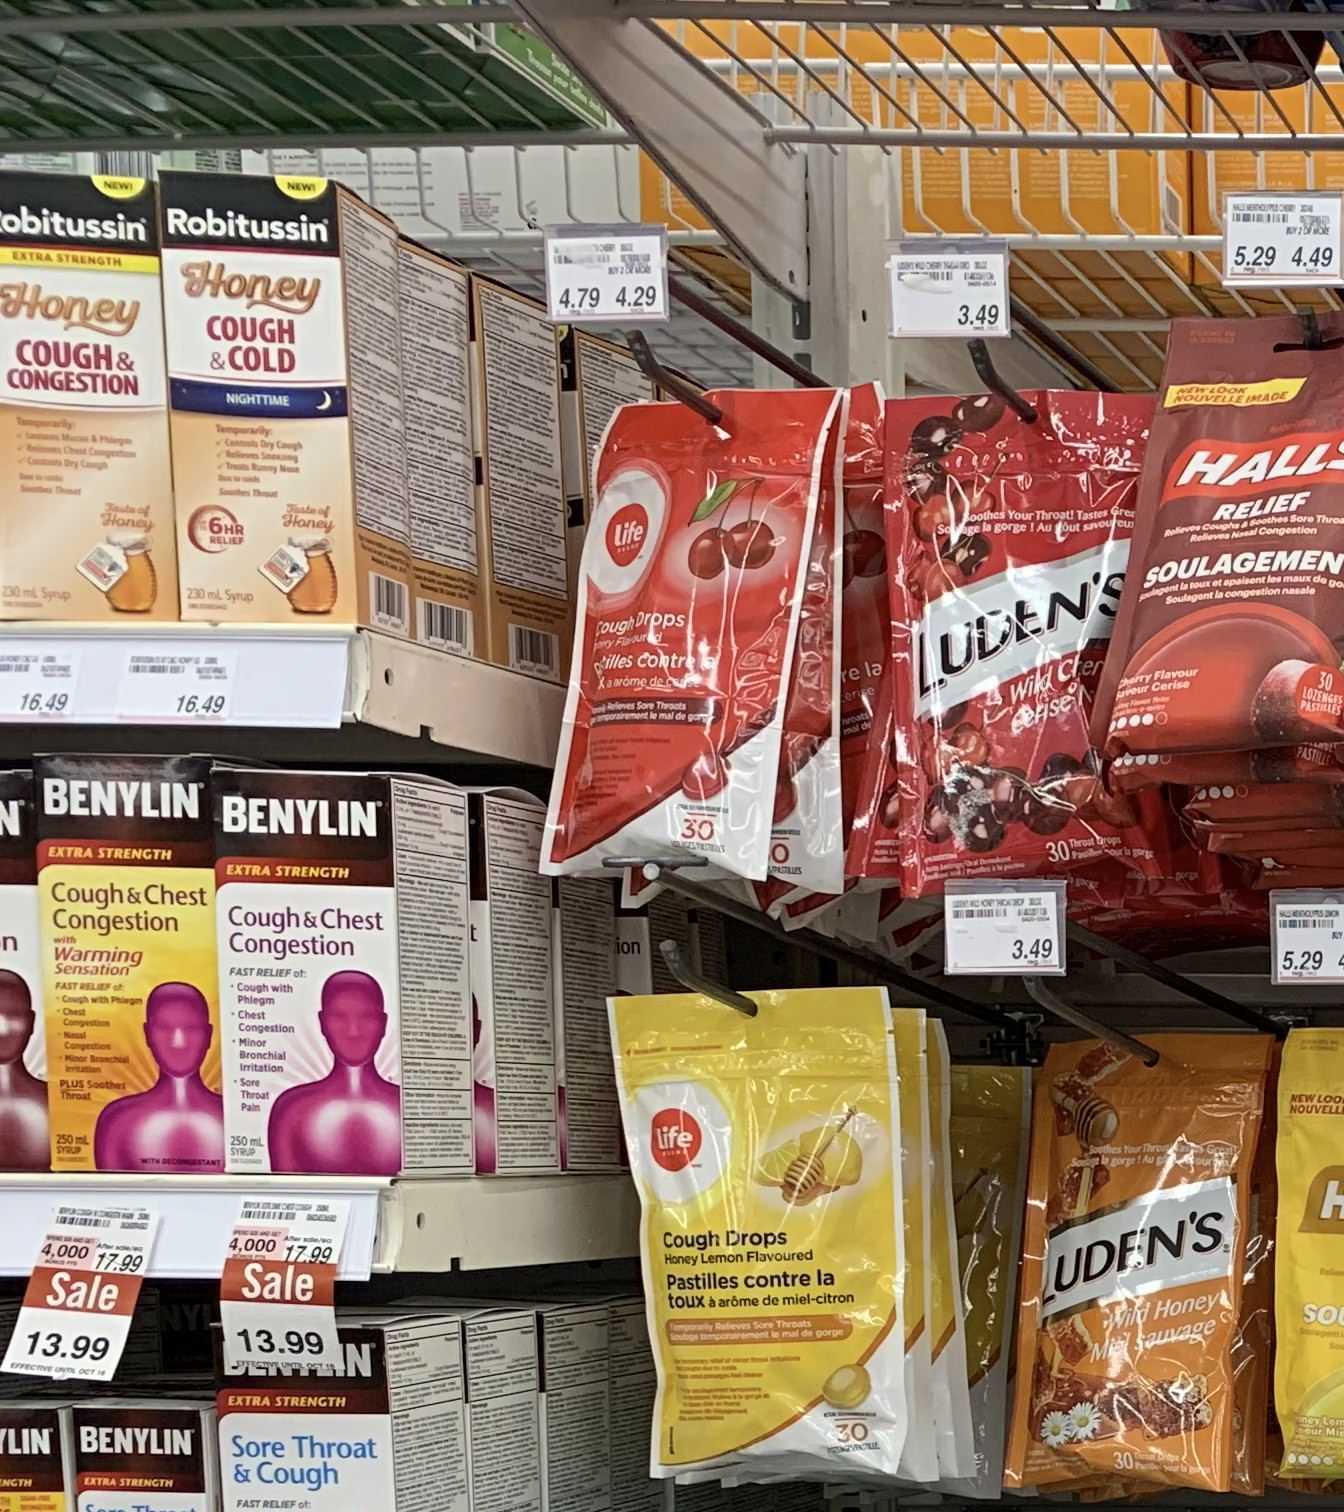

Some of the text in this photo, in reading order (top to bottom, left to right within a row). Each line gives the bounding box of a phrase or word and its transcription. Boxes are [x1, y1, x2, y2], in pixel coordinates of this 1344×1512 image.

[167, 208, 328, 243] Robitussin
[180, 261, 320, 313] Honey
[559, 286, 656, 309] 4.79 4.29
[207, 316, 295, 344] COUGH
[211, 346, 296, 373] & COLD
[226, 393, 290, 407] NIGHTTIME
[917, 573, 1125, 698] LUDEN'S
[176, 695, 225, 714] 16.49
[223, 796, 378, 837] BENYLIN
[228, 906, 384, 932] Cough & Chest
[54, 945, 142, 967] Warming
[229, 932, 355, 958] Congestion
[1012, 938, 1052, 961] 3.49
[664, 1247, 813, 1265] Honey Lemon Flavoured
[241, 1263, 314, 1302] Sale
[237, 1328, 324, 1357] 13.99
[232, 1434, 378, 1460] Sore Throat
[233, 1461, 340, 1490] & Cough
